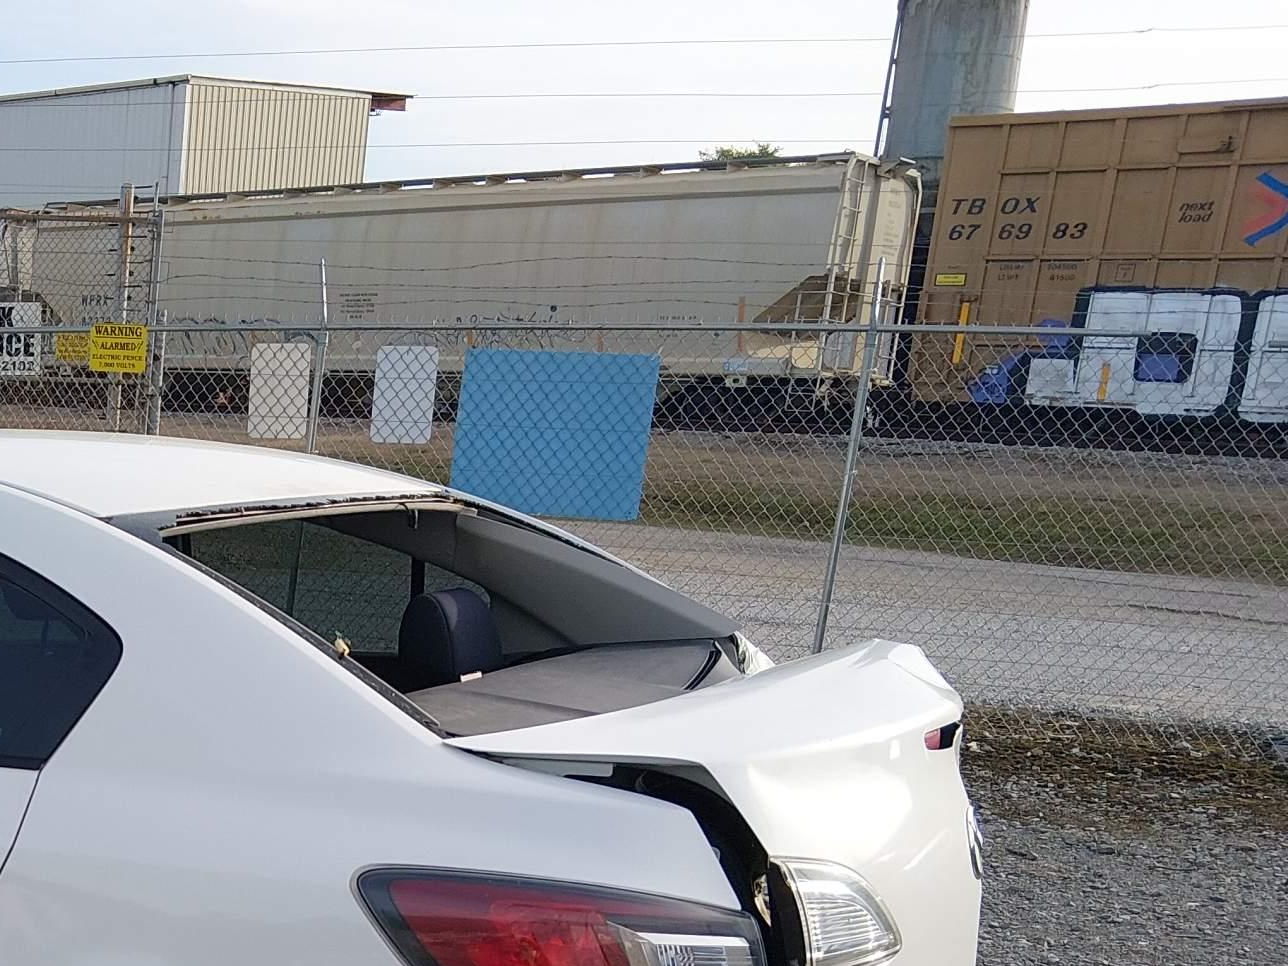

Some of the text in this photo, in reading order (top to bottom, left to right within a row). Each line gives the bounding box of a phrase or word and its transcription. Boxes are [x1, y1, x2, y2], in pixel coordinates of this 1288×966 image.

[1179, 200, 1214, 212] next
[1178, 210, 1213, 223] load
[948, 222, 1088, 240] 67 69 83
[95, 326, 143, 337] WARNING
[99, 341, 137, 351] ALARMED
